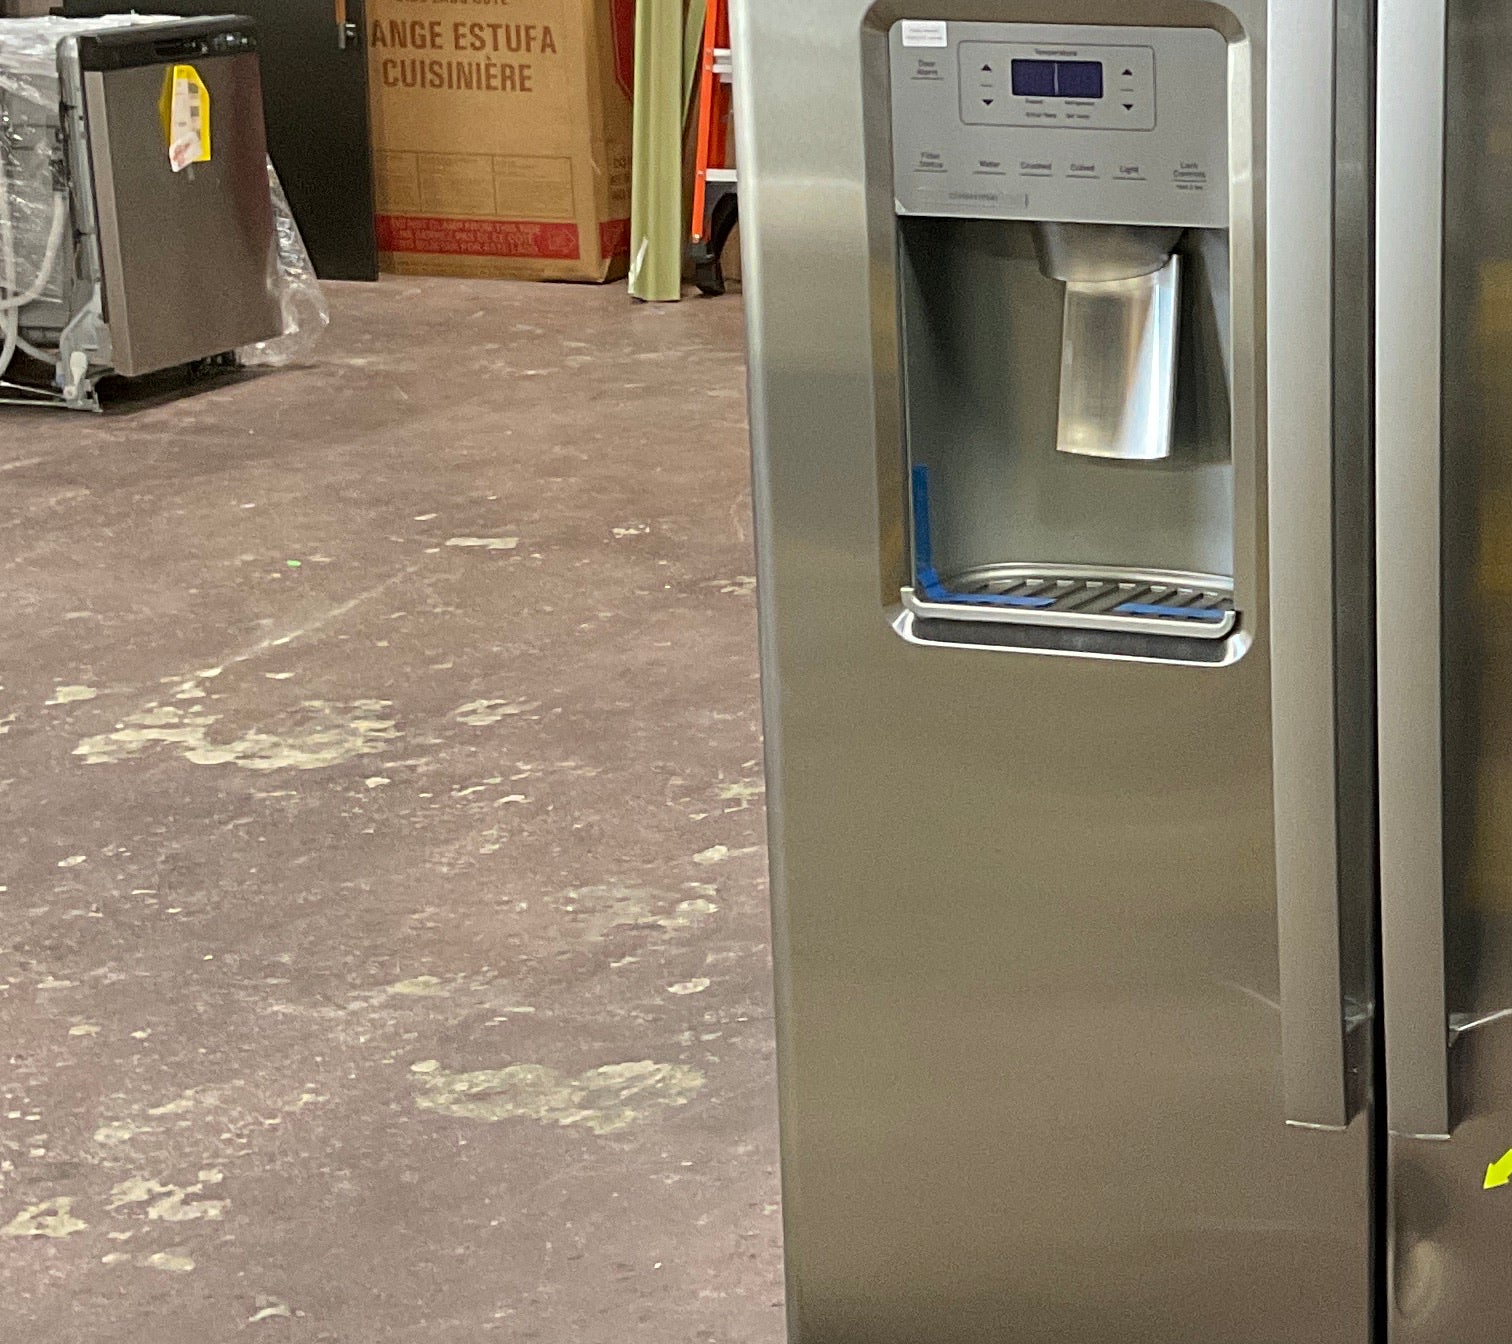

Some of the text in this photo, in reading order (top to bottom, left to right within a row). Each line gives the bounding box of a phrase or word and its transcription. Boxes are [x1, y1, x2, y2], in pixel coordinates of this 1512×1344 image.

[370, 19, 557, 54] ANGE ESTUFA
[382, 56, 533, 93] CUISINIÈRE
